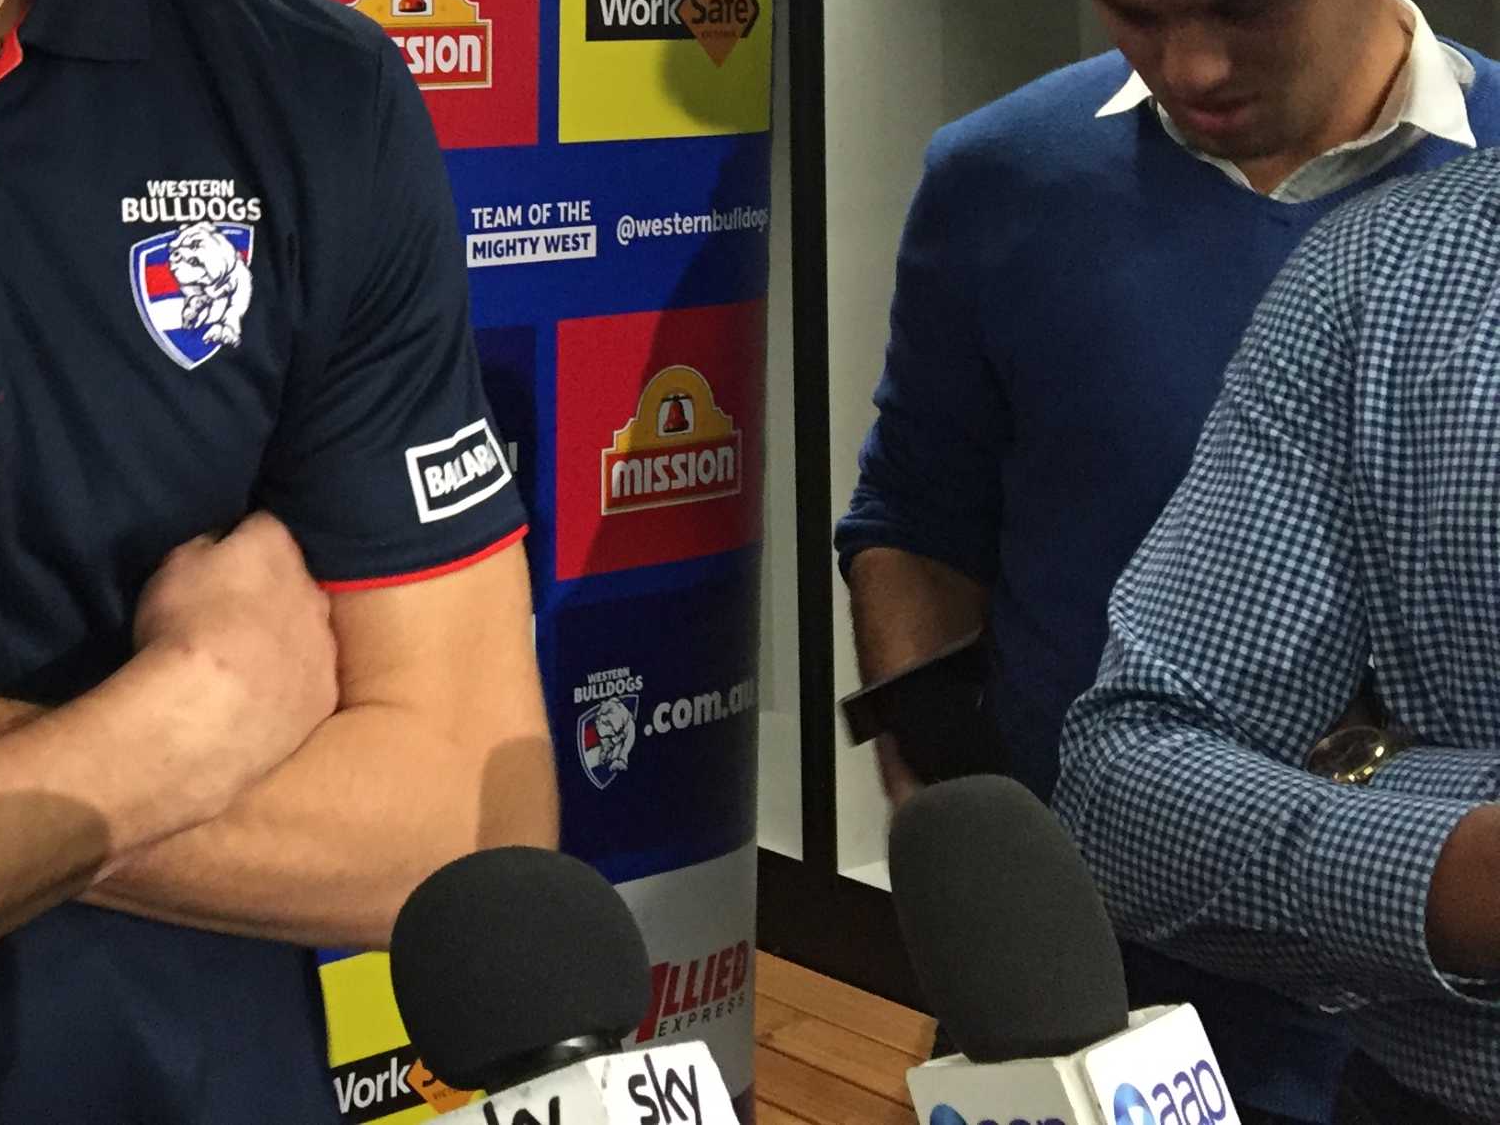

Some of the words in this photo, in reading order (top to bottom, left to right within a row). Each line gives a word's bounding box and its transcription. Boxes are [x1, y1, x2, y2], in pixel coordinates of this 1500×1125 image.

[147, 179, 234, 197] WESTERN
[121, 197, 262, 222] BULLDOGS
[471, 205, 522, 230] TEAM
[528, 202, 554, 226] OF
[557, 200, 592, 223] THE
[472, 235, 541, 261] MIGHTY
[544, 233, 592, 255] WEST
[587, 667, 630, 685] WESTERN
[573, 675, 644, 704] BULLDOGS
